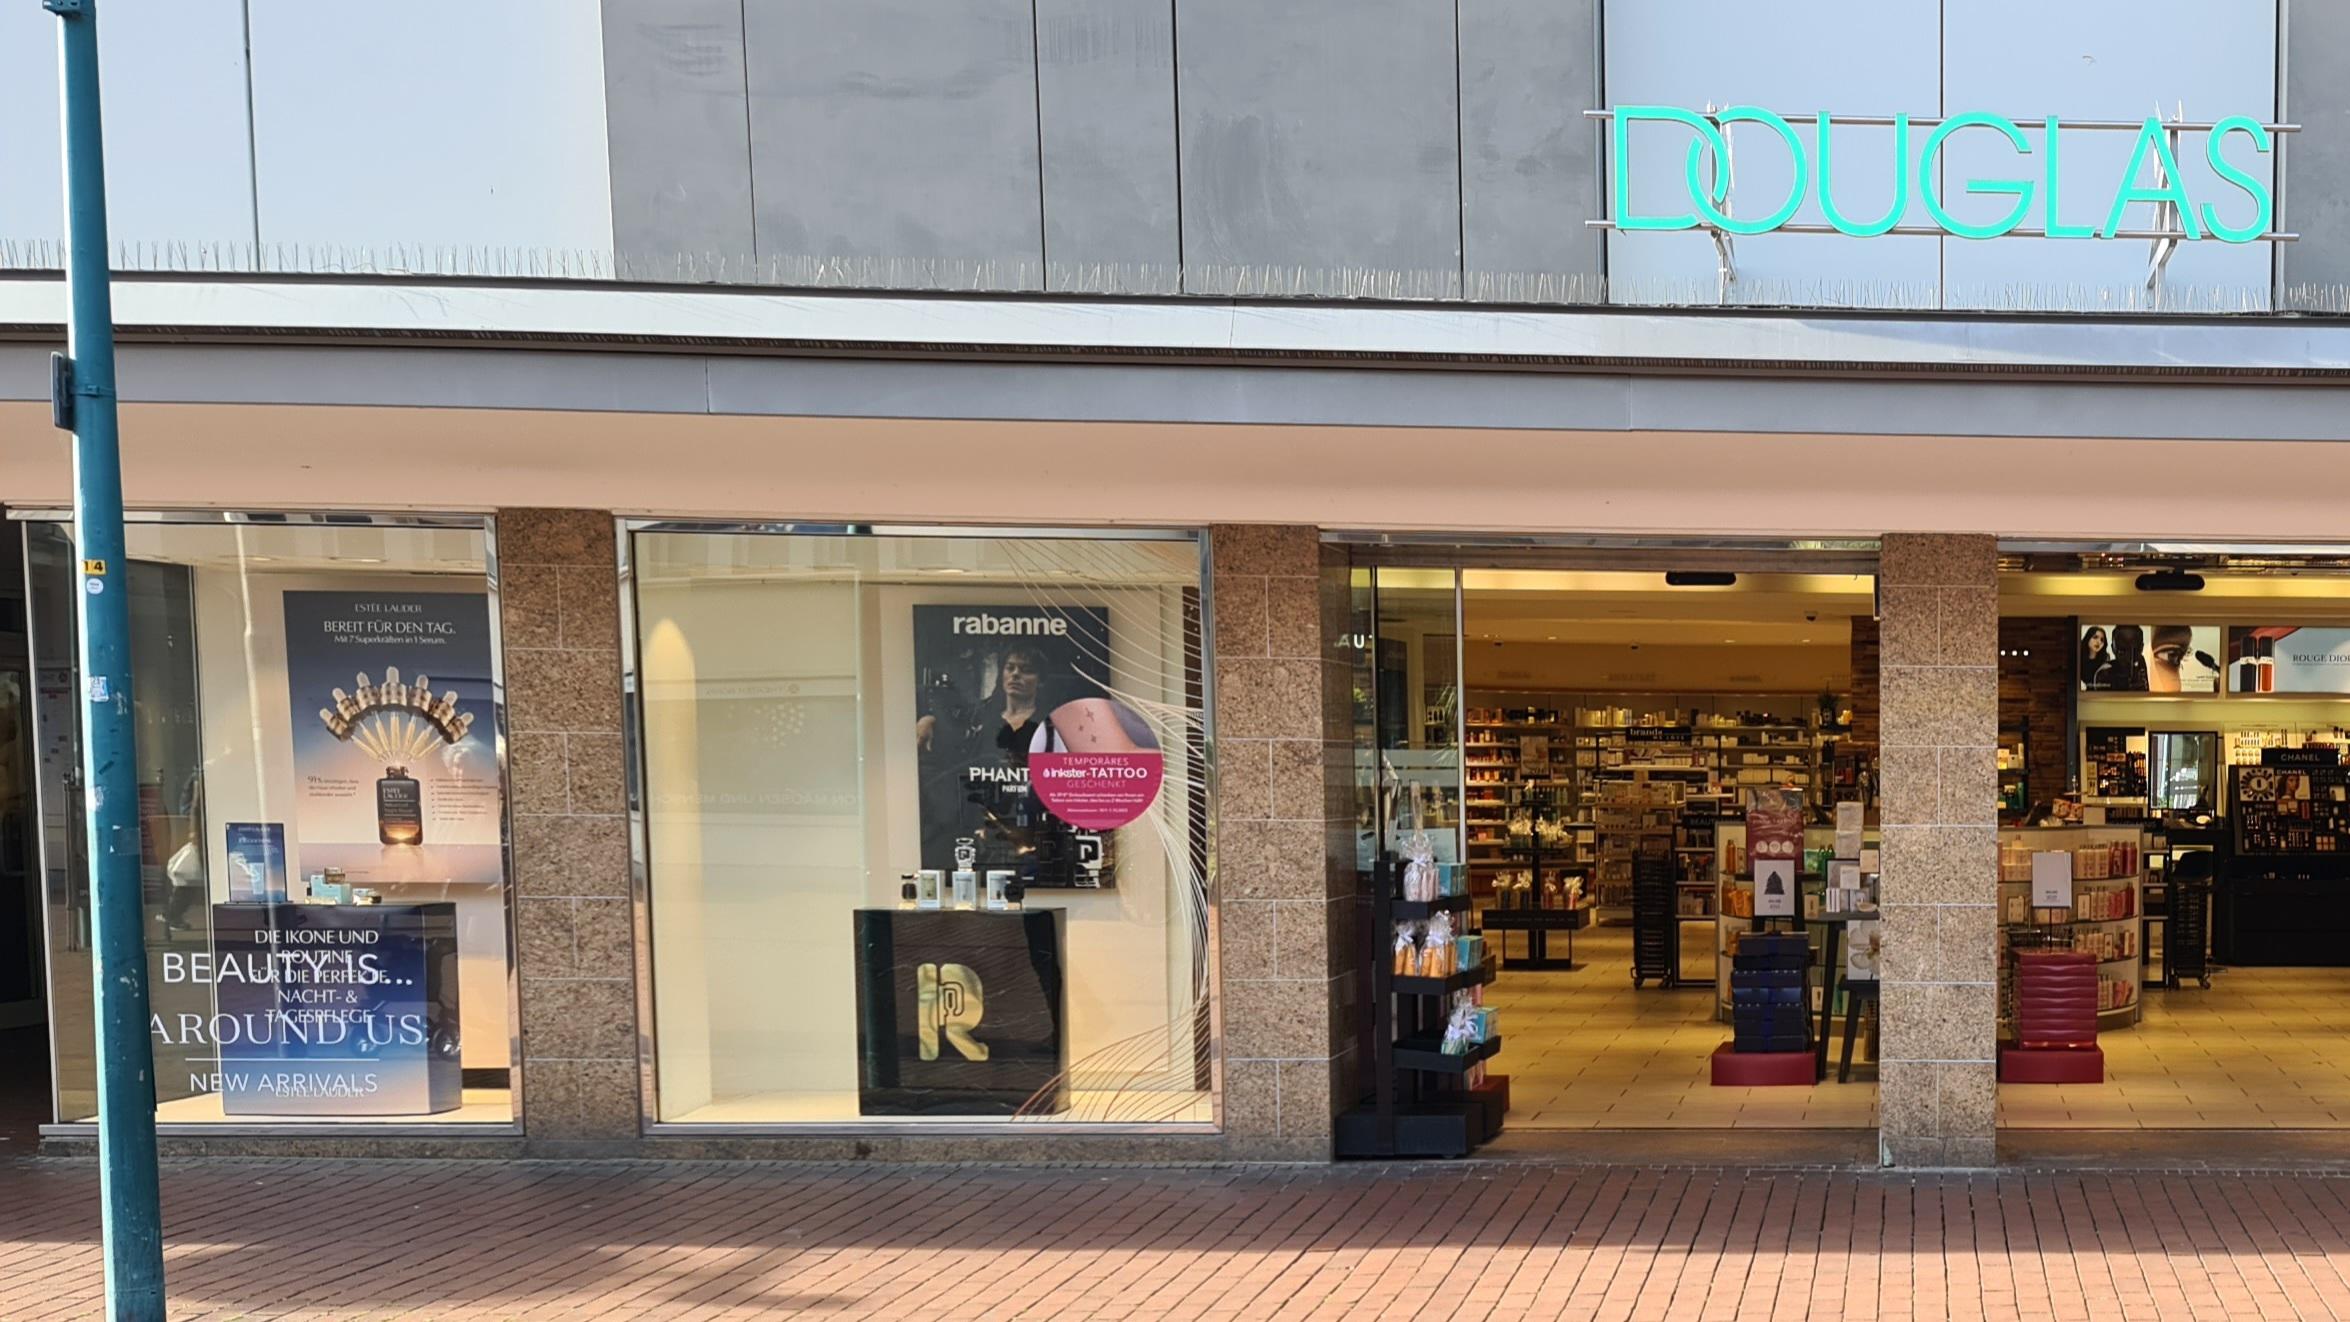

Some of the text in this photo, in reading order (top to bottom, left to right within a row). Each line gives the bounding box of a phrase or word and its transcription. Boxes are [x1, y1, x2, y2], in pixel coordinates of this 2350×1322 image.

[1614, 104, 2271, 243] DOUGLAS
[384, 603, 423, 613] LAUDER
[323, 618, 457, 635] BEREIT FÜR DEN TAG.
[953, 613, 1068, 636] rabanne
[333, 634, 348, 644] Mit
[2292, 654, 2326, 662] ROUGE
[1062, 755, 1130, 766] TEMPORÄRES
[2280, 753, 2320, 761] CHANEL
[968, 766, 1031, 782] PHANT
[1066, 780, 1128, 789] GESCHENKT
[254, 930, 379, 944] DIE IKONE UND
[281, 950, 353, 964] ROUTINE
[162, 952, 413, 985] BEAUTY IS...
[285, 969, 311, 983] DIE
[314, 969, 387, 984] PERFEKE
[277, 989, 358, 1003] NACHT- &
[265, 1009, 371, 1024] TAGESPFLEGE
[151, 1013, 347, 1045] AROUND
[190, 1073, 378, 1094] NEW ARRIVALS
